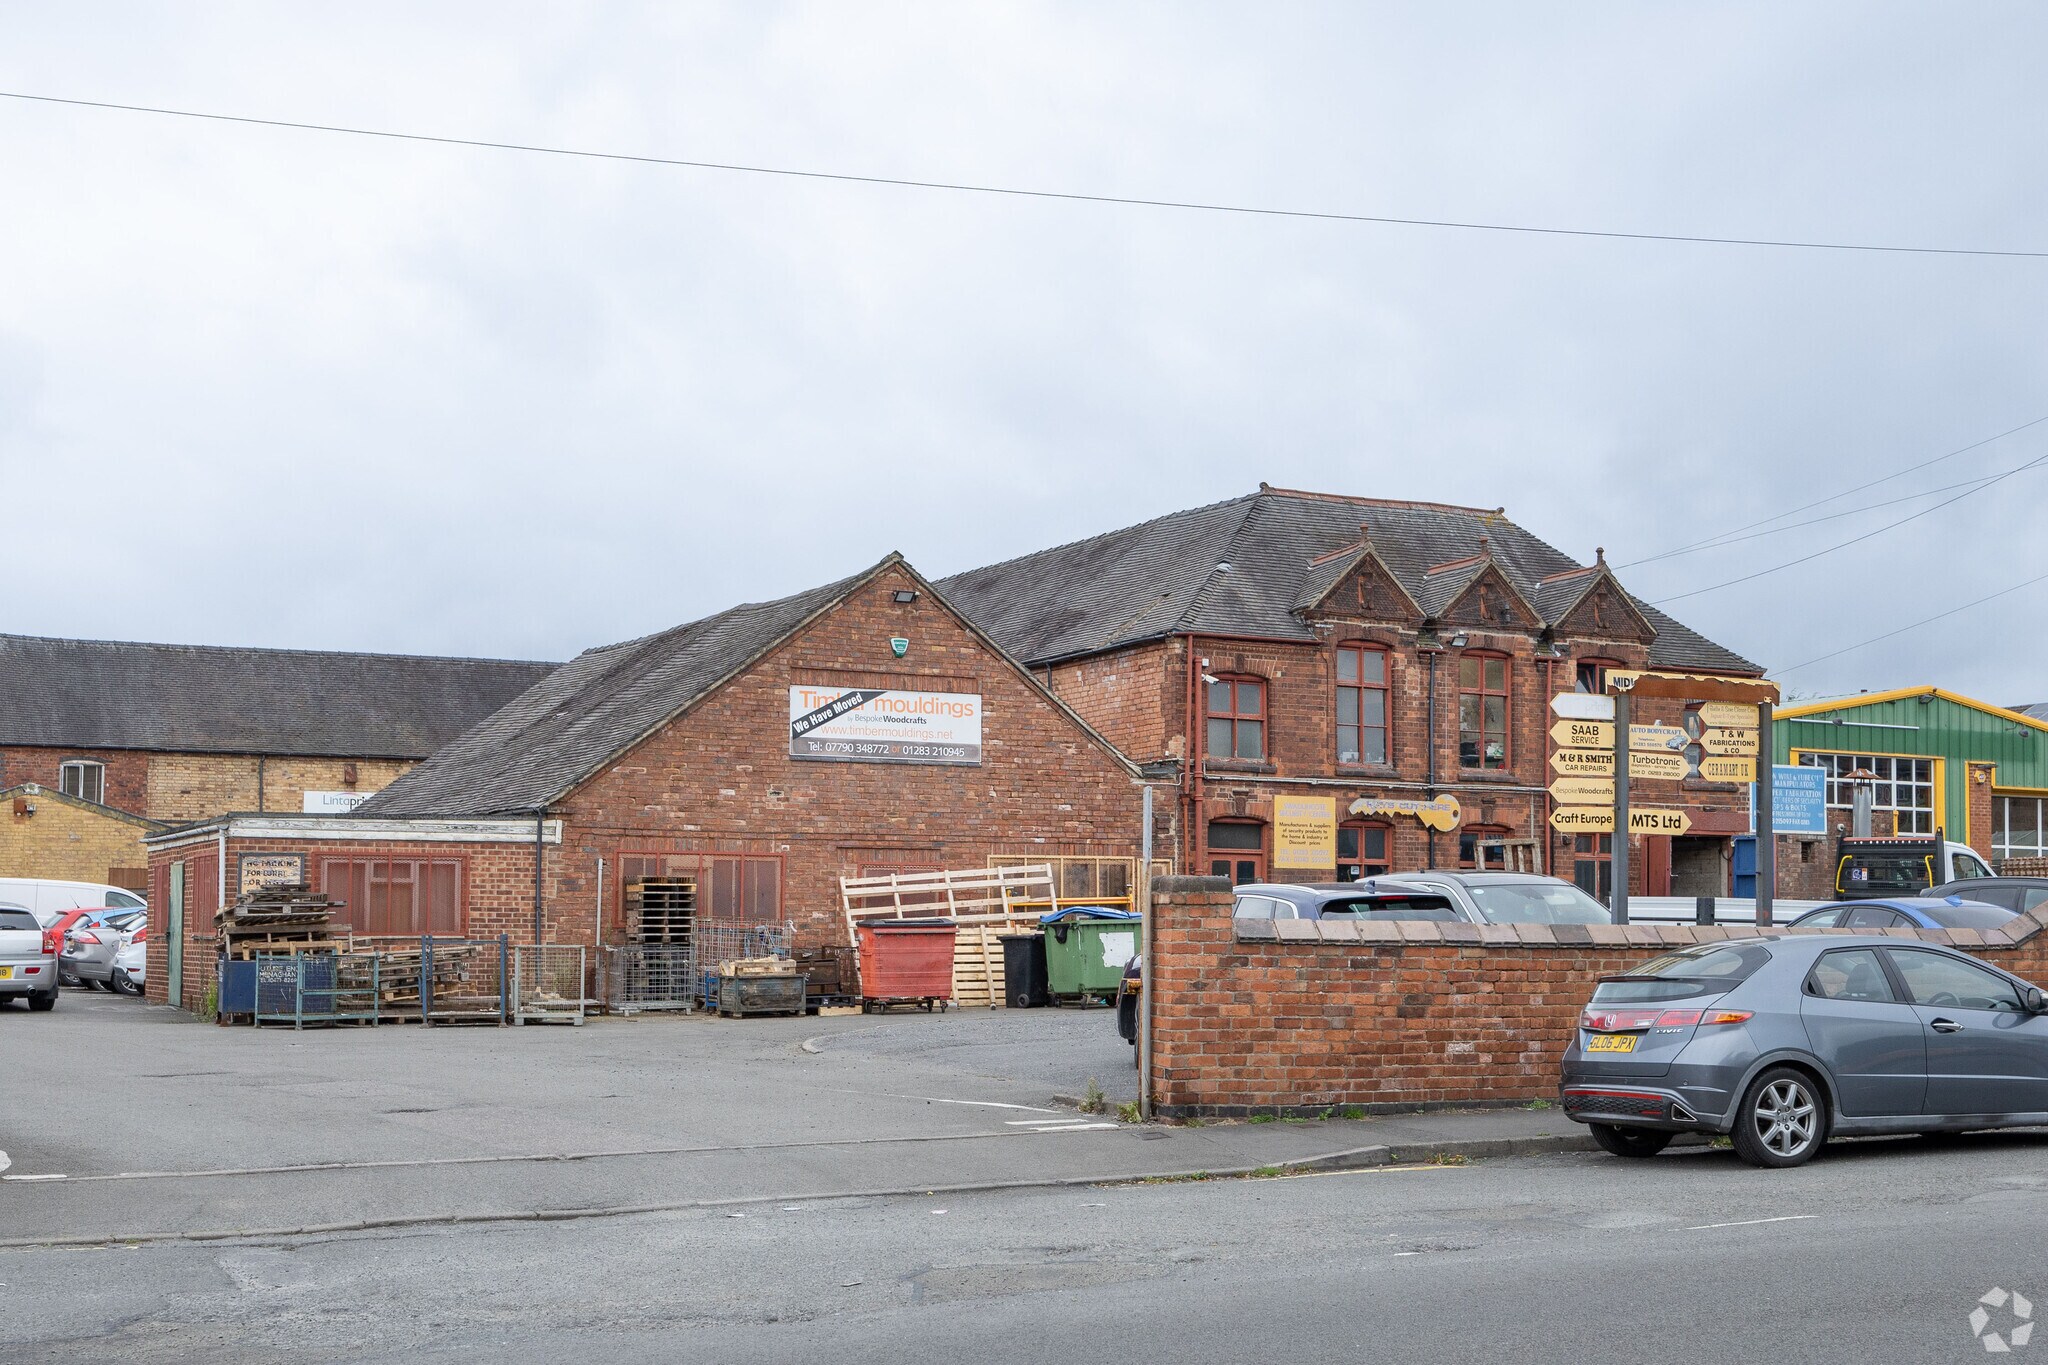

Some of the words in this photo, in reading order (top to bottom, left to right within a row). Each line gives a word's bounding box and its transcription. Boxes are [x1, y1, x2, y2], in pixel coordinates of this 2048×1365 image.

[793, 721, 810, 734] We
[809, 709, 833, 727] Have
[833, 692, 864, 714] Moved
[874, 697, 974, 718] mouldings
[821, 725, 953, 740] www.timbermouldings.net
[1571, 724, 1599, 736] SAAB
[1720, 730, 1725, 738] T
[1728, 730, 1734, 738] &
[1571, 736, 1599, 745] SERVICE
[1709, 739, 1755, 747] FABRICATIONS
[808, 742, 823, 752] Tel:
[825, 742, 854, 753] 07790
[856, 744, 890, 755] 348772
[892, 746, 900, 754] or
[903, 745, 930, 756] 01283
[933, 746, 965, 757] 210945
[1559, 753, 1566, 762] M
[1568, 753, 1576, 762] &
[1577, 754, 1583, 762] R
[1585, 754, 1613, 764] SMITH
[1631, 754, 1680, 766] Turbotronic
[1580, 764, 1607, 773] REPAIRS
[1708, 763, 1738, 776] CERAMART
[1741, 763, 1749, 776] UK
[1774, 780, 1816, 788] MANIPULATORS
[1785, 789, 1822, 798] FABRICATION
[1399, 802, 1419, 810] CUT
[1554, 813, 1579, 824] Craft
[1580, 814, 1612, 826] Europe
[1631, 814, 1658, 828] MTS
[1662, 815, 1681, 829] Ltd
[246, 869, 261, 877] FOR
[1590, 1035, 1612, 1048] GL06
[1613, 1036, 1634, 1049] JPX
